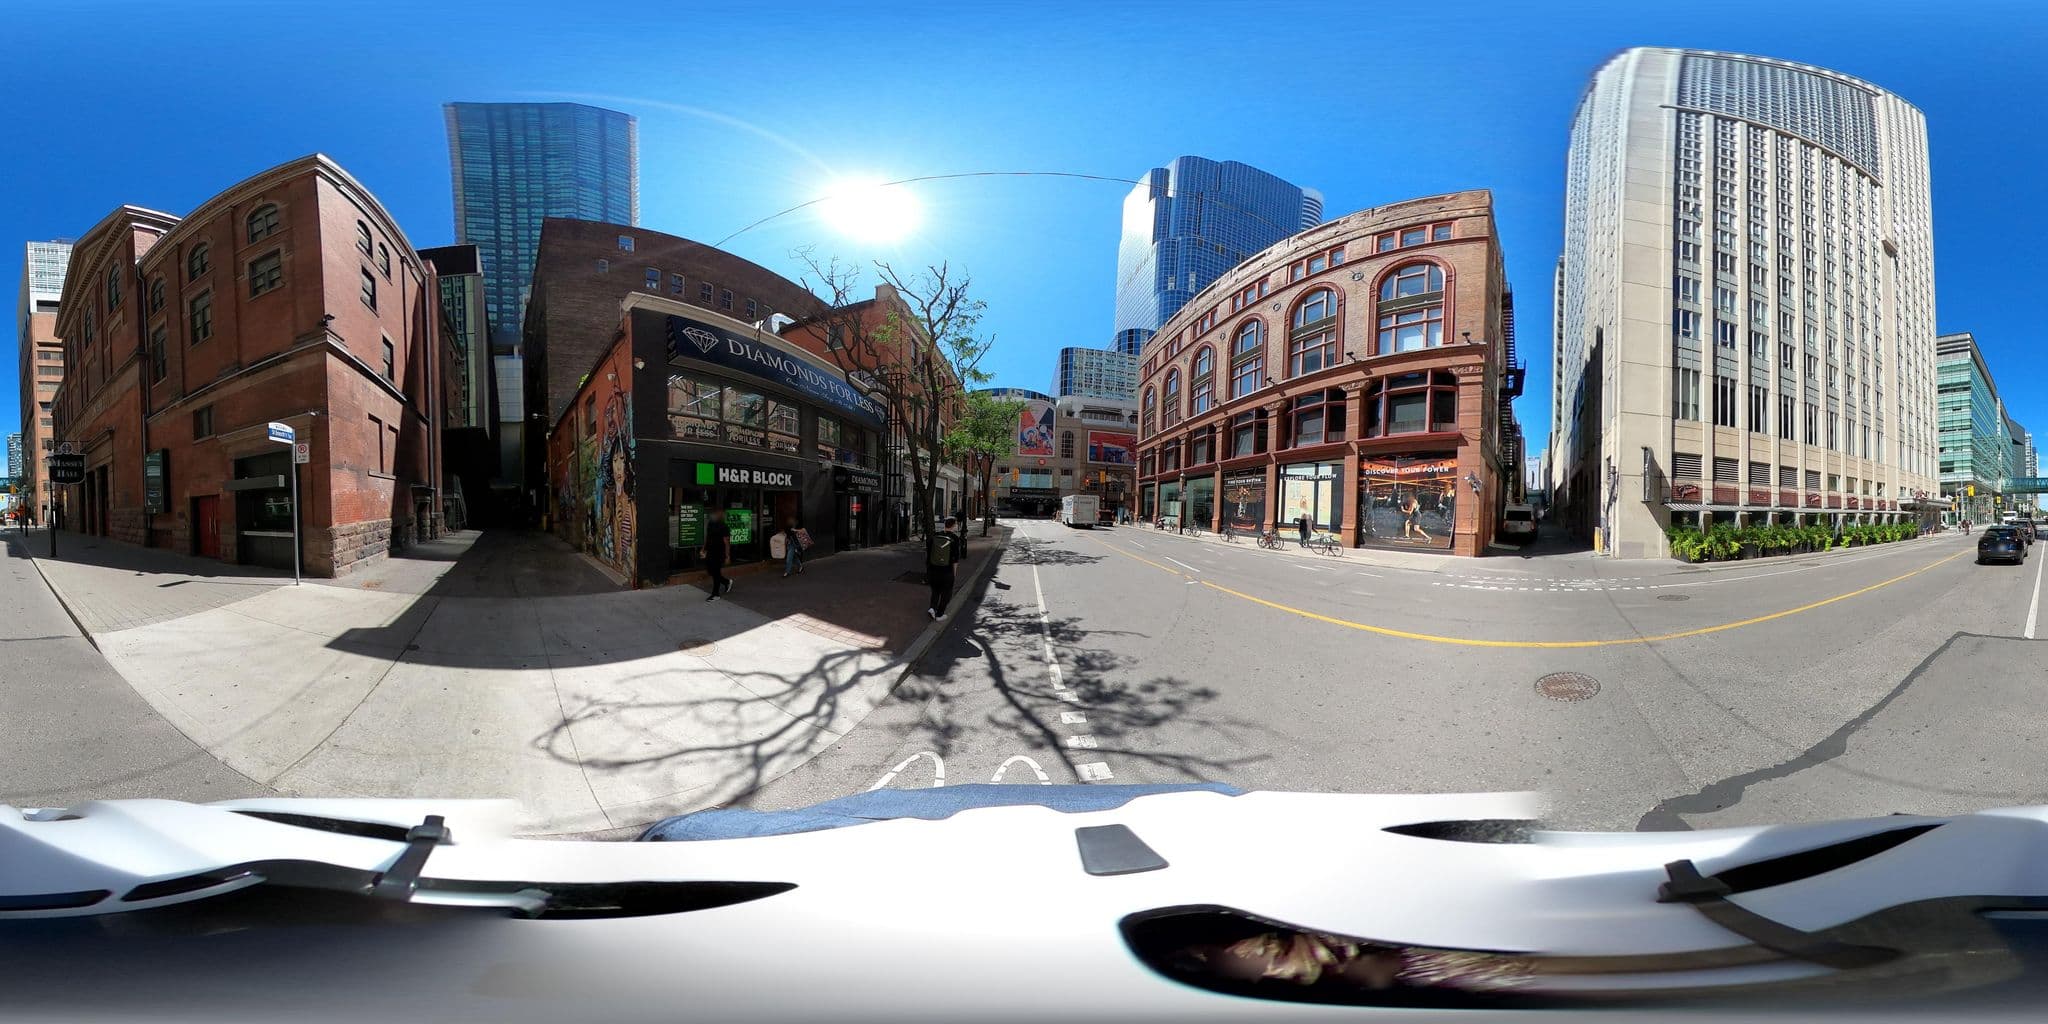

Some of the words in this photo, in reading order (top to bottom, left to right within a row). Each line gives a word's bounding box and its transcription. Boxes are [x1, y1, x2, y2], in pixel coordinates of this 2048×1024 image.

[726, 338, 827, 390] DIAMONDS
[829, 381, 853, 402] FOR
[853, 394, 875, 414] LESS
[719, 467, 750, 484] H&R
[753, 470, 793, 486] BLOCK
